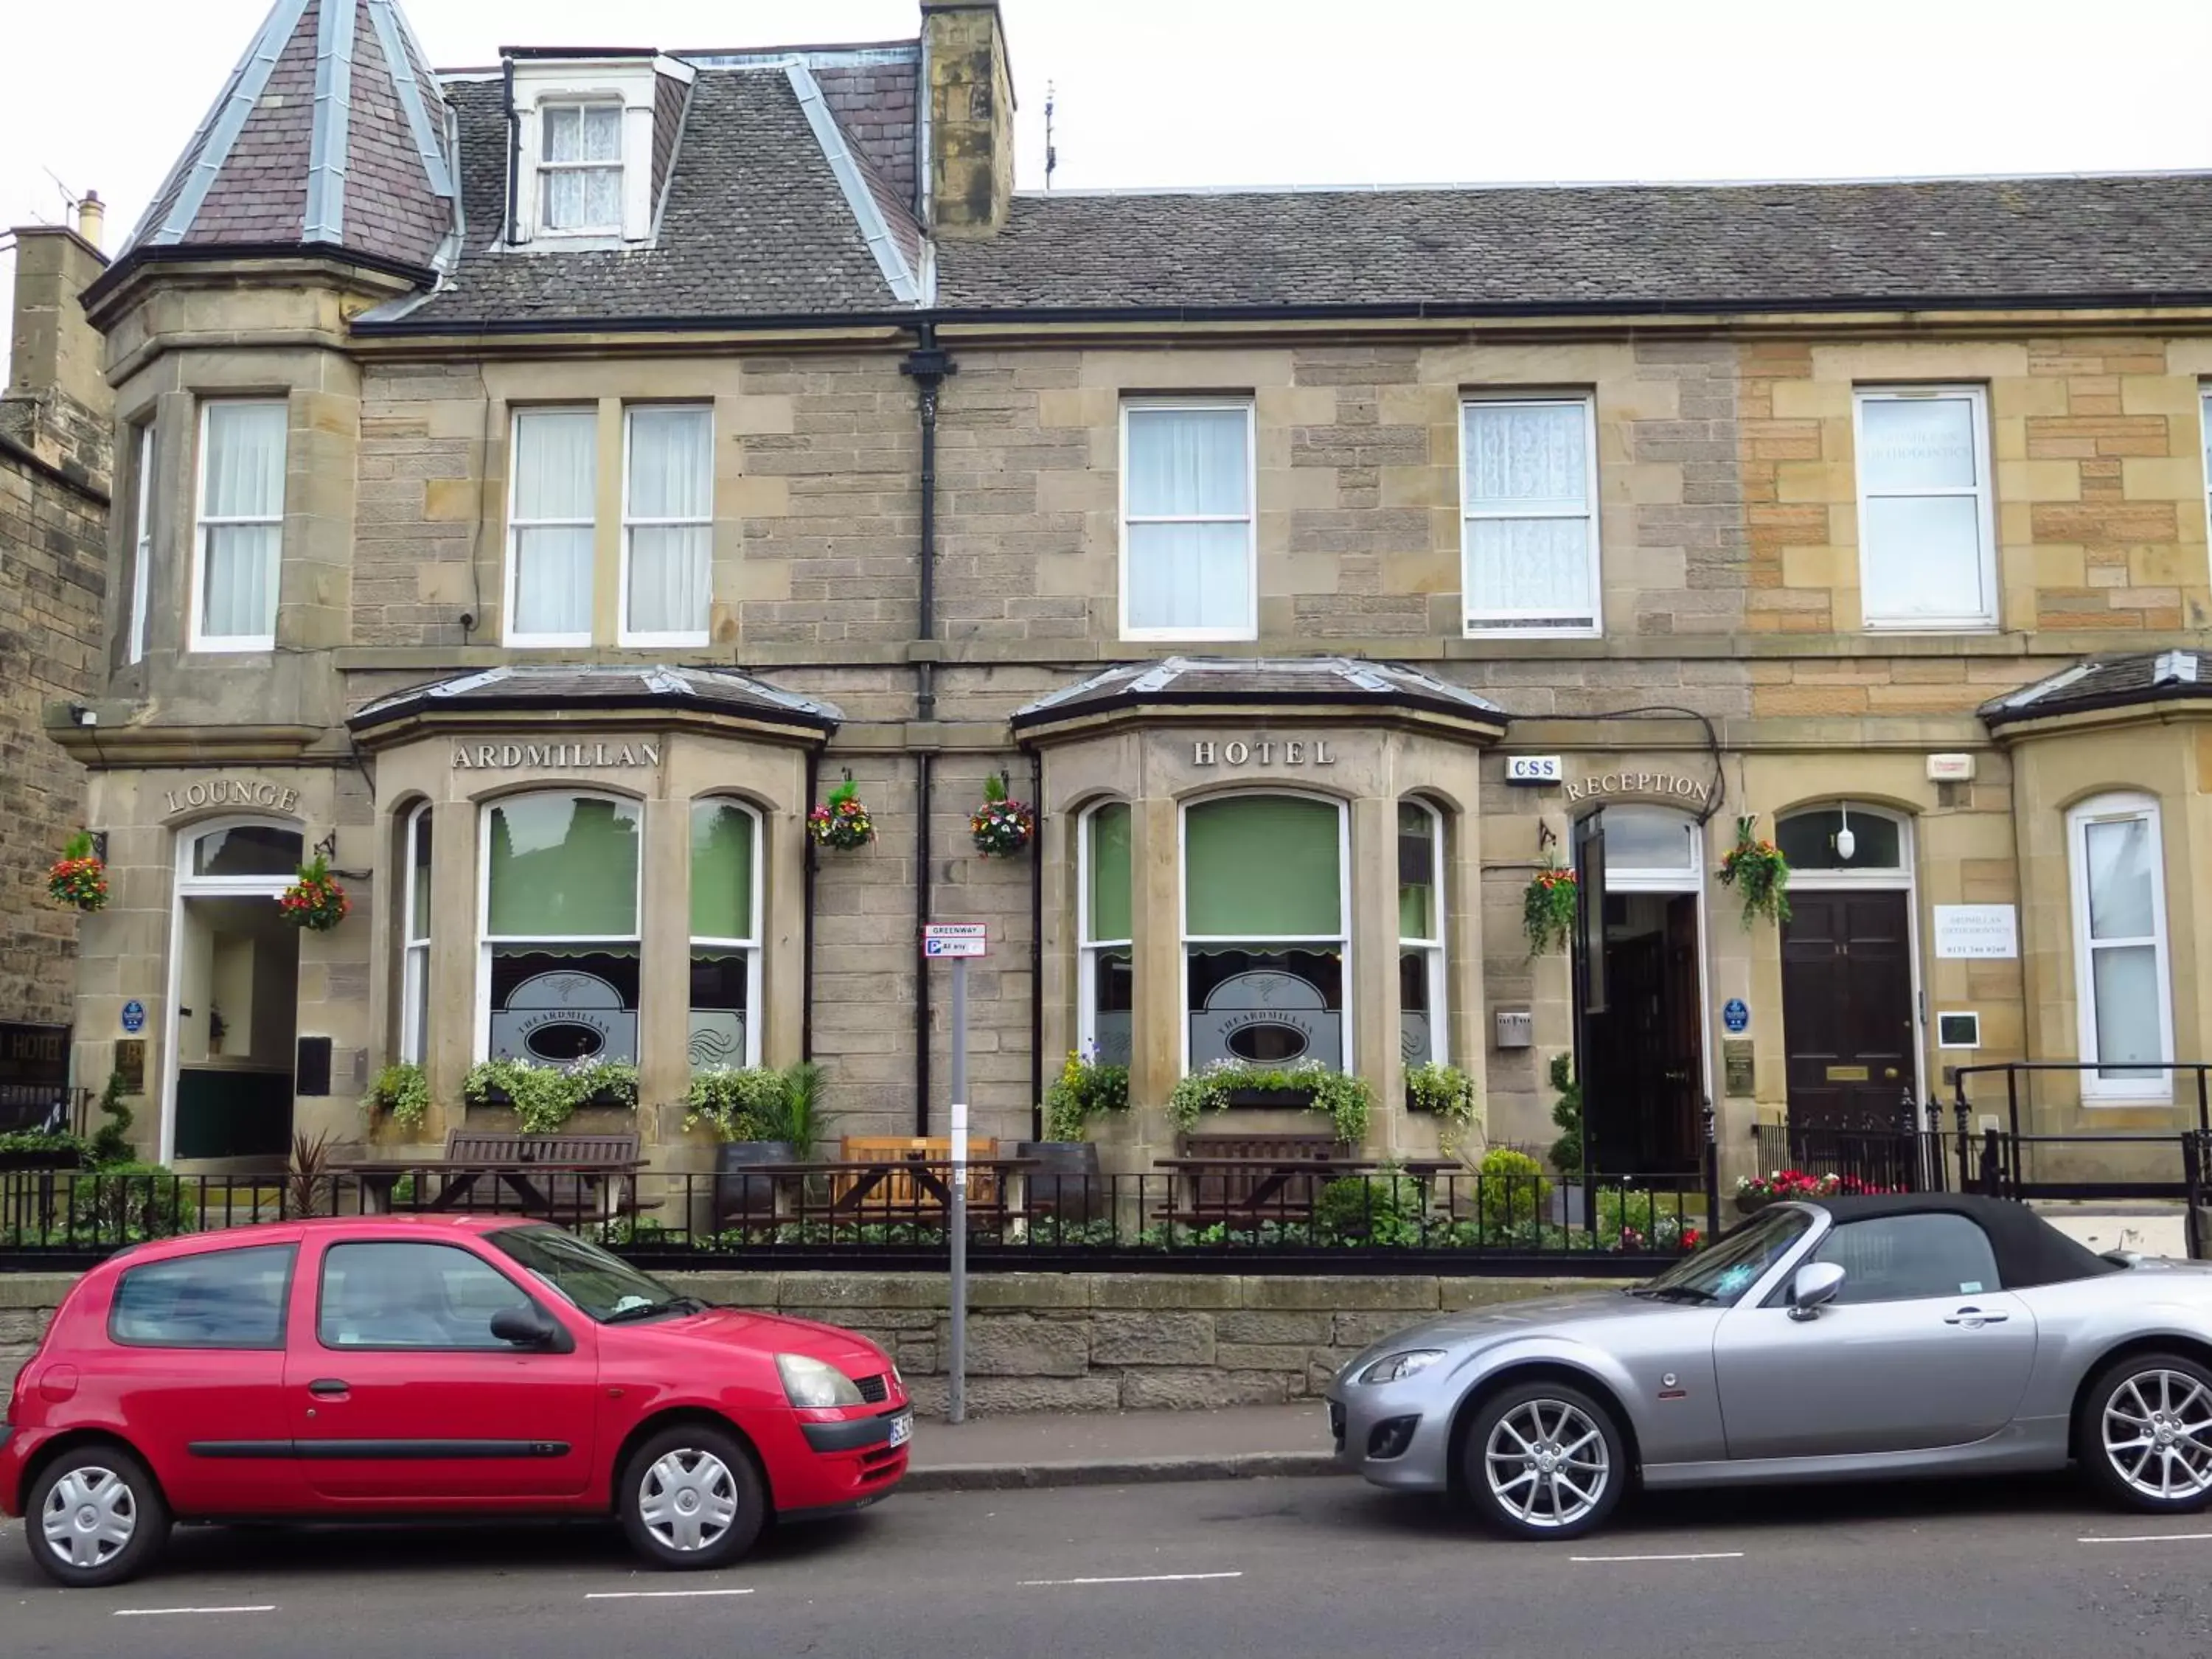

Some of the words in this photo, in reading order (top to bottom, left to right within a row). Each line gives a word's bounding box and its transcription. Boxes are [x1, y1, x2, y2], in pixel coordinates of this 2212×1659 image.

[452, 743, 661, 768] ARDMILLAN
[1193, 741, 1335, 765] HOTEL
[1514, 760, 1554, 775] CSS
[165, 780, 299, 813] LOUNGE
[1565, 772, 1711, 802] RECEPTION
